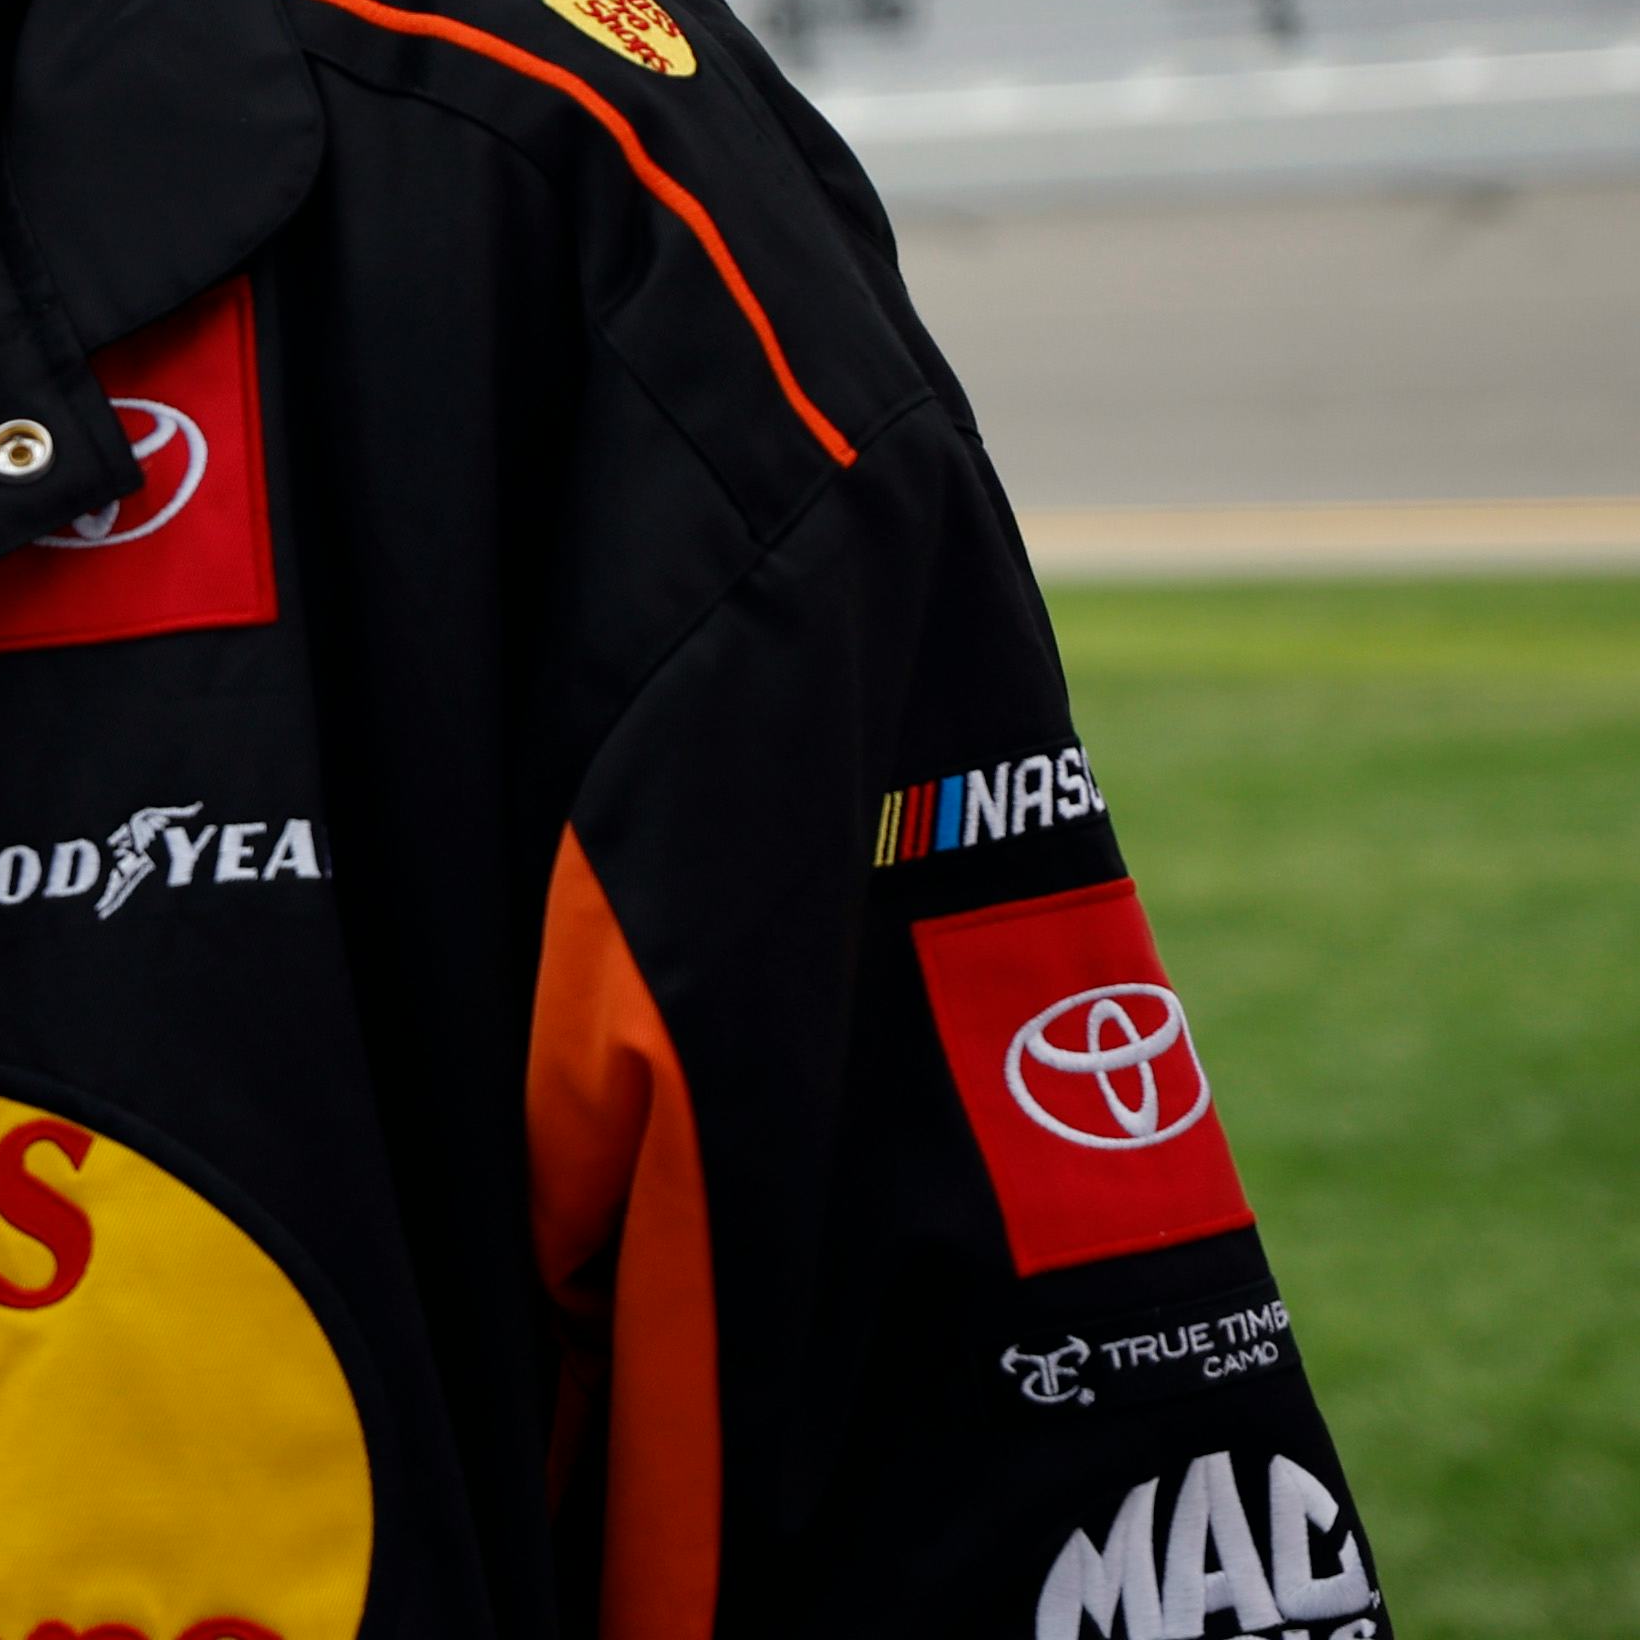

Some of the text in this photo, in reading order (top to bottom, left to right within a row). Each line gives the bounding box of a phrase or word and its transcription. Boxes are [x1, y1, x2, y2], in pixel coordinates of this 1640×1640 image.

[573, 0, 674, 73] Shops
[1100, 1322, 1214, 1370] TRUE
[1203, 1340, 1279, 1380] CAMO
[1035, 1450, 1373, 1640] MAC
